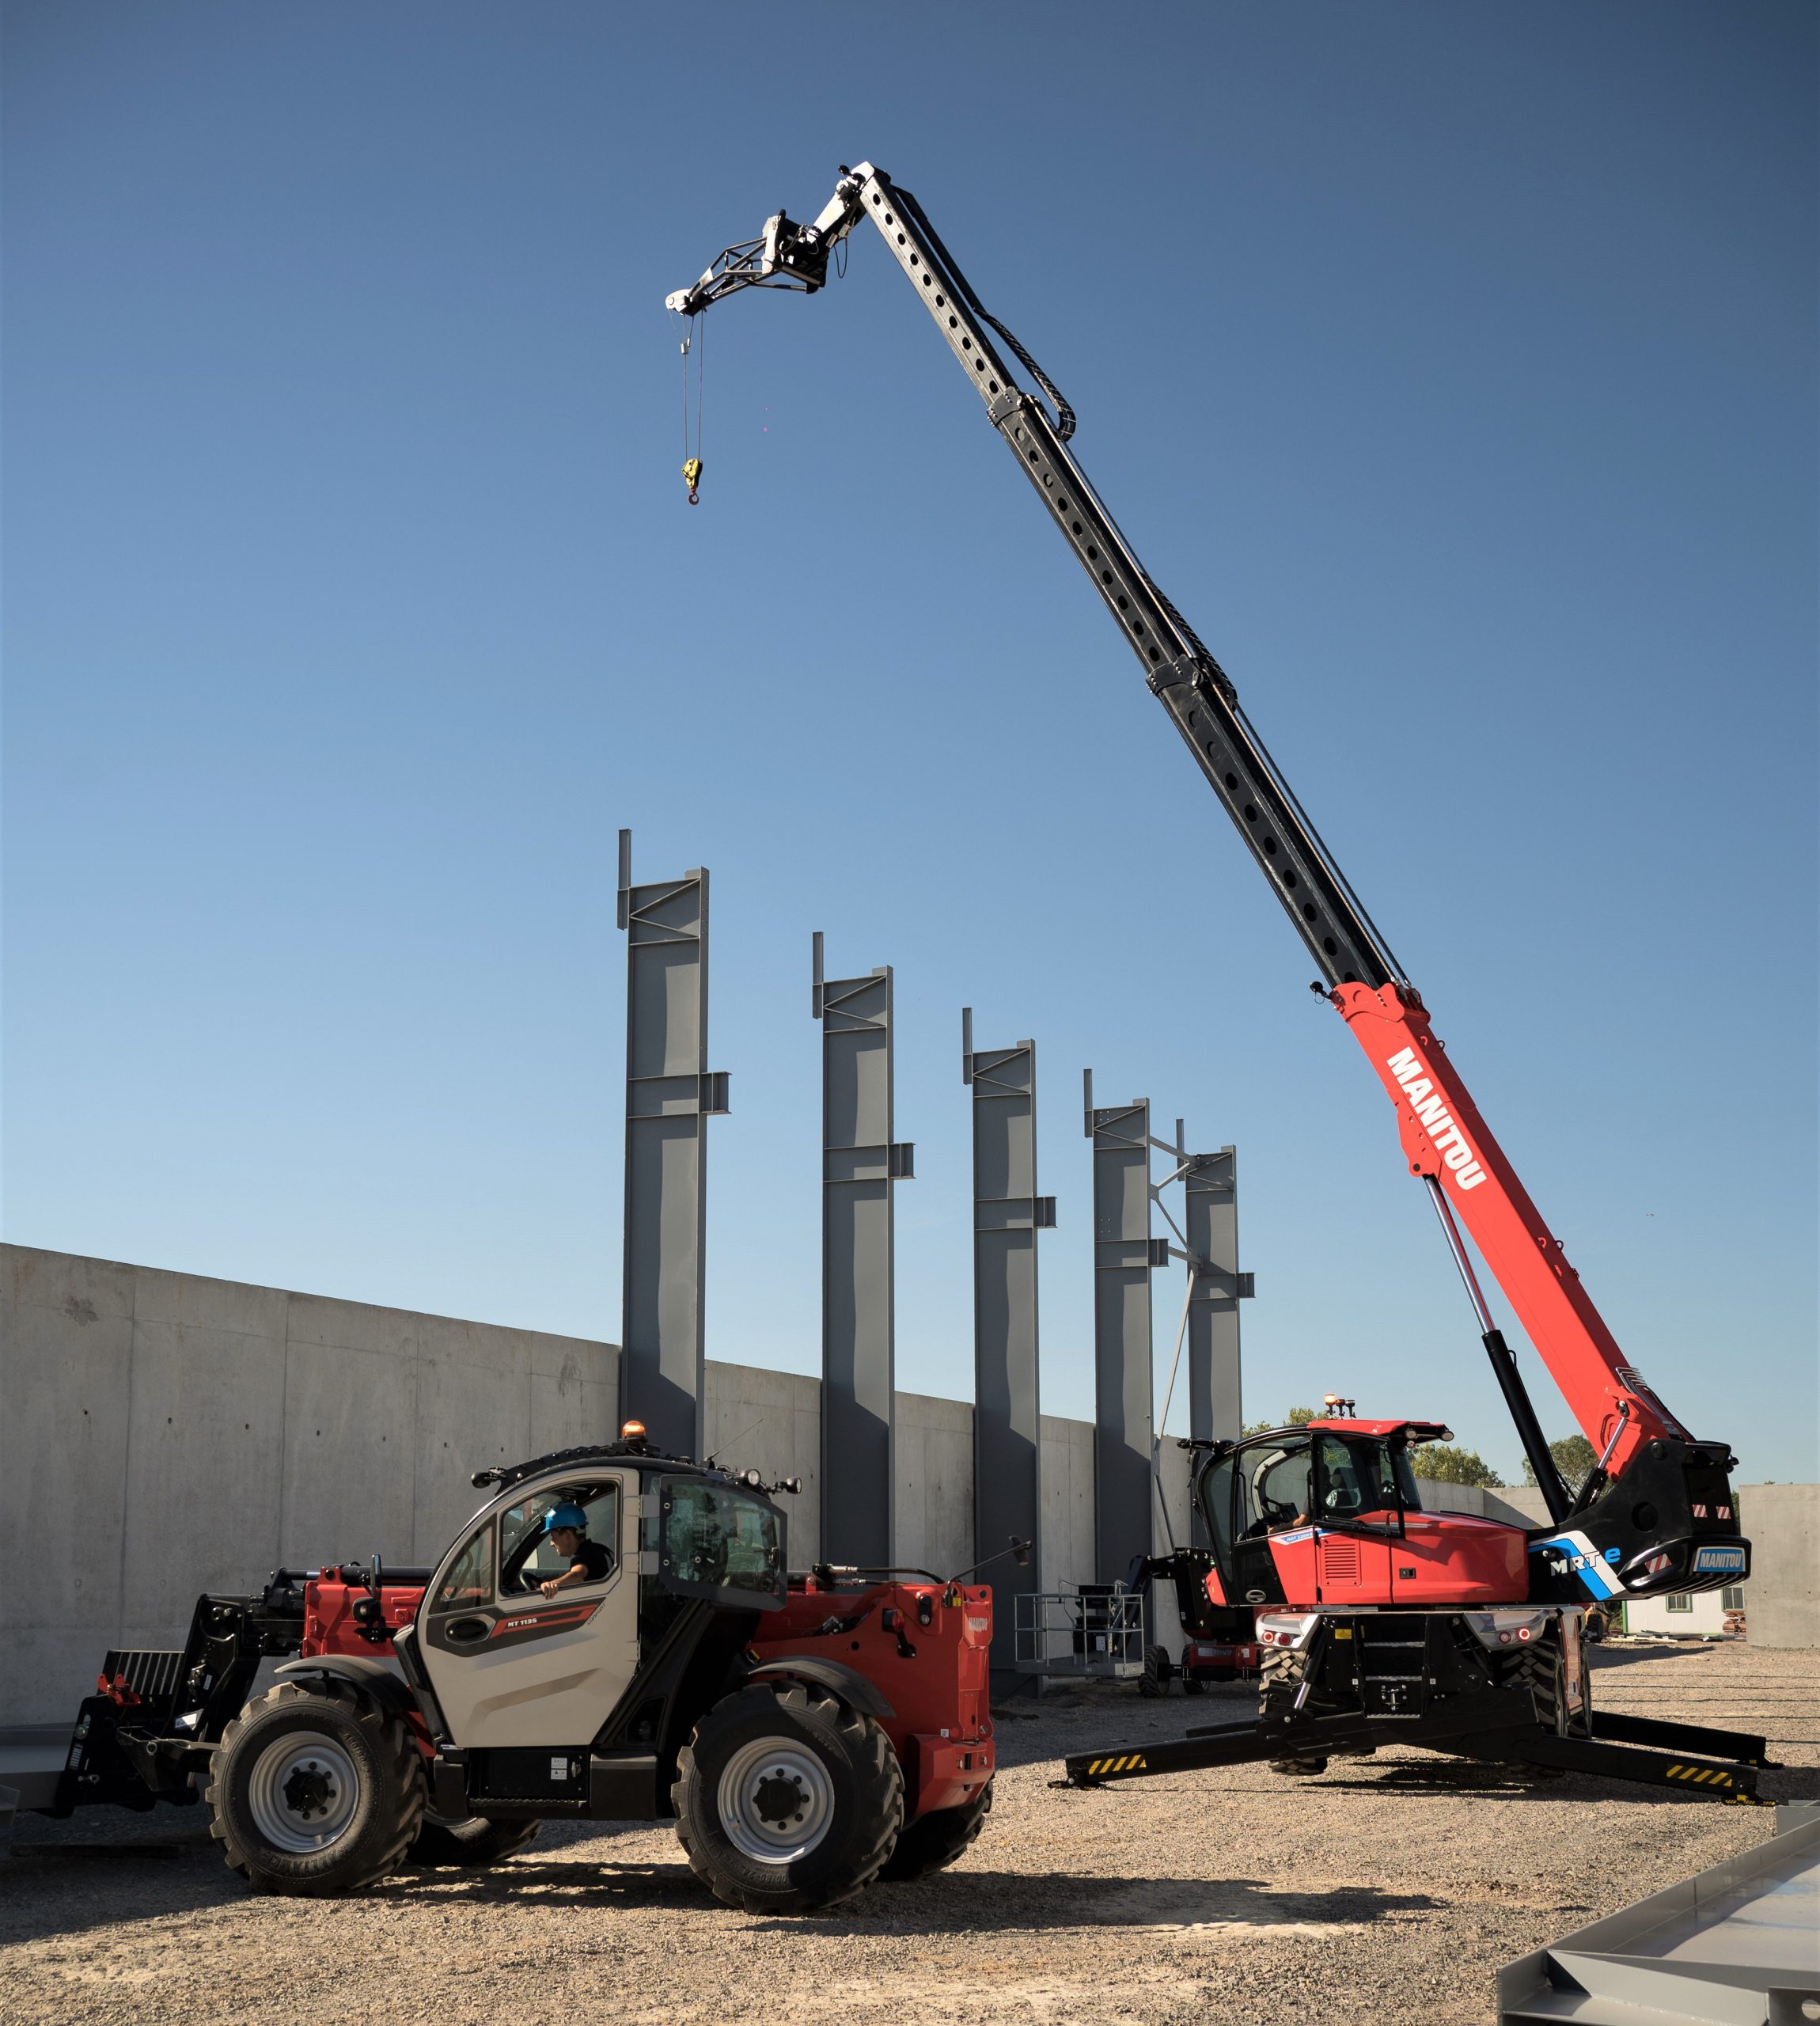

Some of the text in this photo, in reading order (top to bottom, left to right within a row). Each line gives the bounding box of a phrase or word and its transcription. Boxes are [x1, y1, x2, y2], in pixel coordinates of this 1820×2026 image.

[1386, 1046, 1487, 1190] MANITOU
[1550, 1547, 1621, 1576] MRT e
[1700, 1553, 1741, 1568] MANITOU
